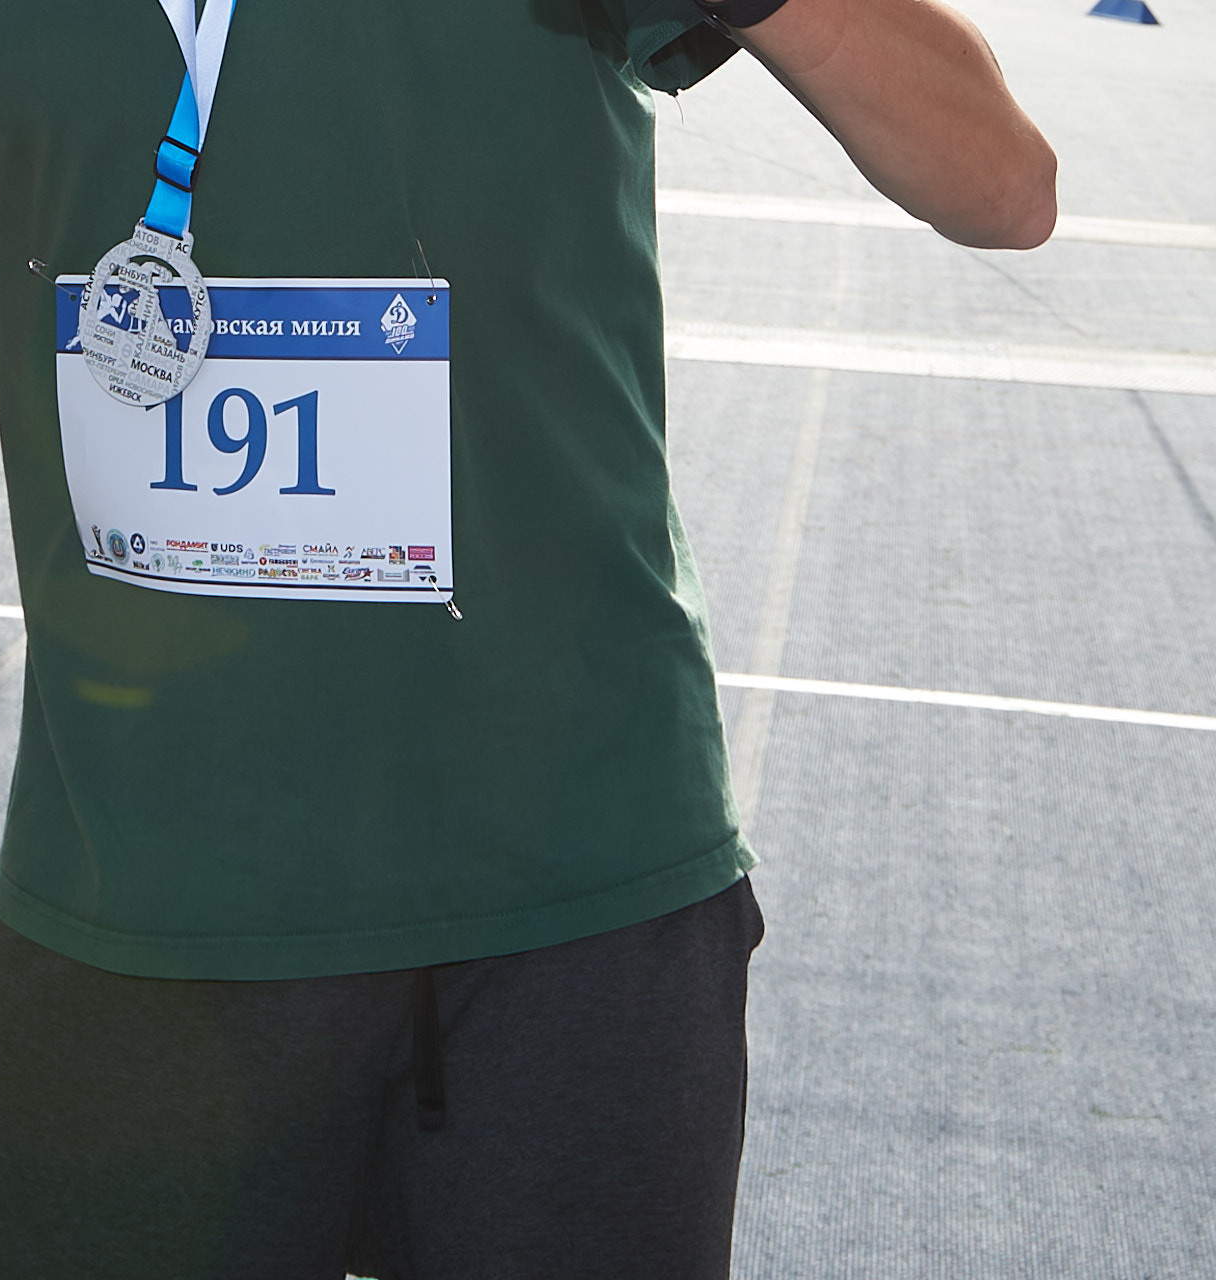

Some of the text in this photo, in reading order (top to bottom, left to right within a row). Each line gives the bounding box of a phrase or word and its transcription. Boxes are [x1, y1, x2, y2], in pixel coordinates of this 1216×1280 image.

[291, 320, 362, 337] миля
[151, 345, 186, 363] КАЗАНЬ
[130, 359, 173, 383] МОСКВА
[108, 384, 142, 403] ИЖЕВСК
[145, 387, 336, 496] 191
[220, 544, 244, 553] UDS
[302, 543, 339, 555] СМАЙЛ
